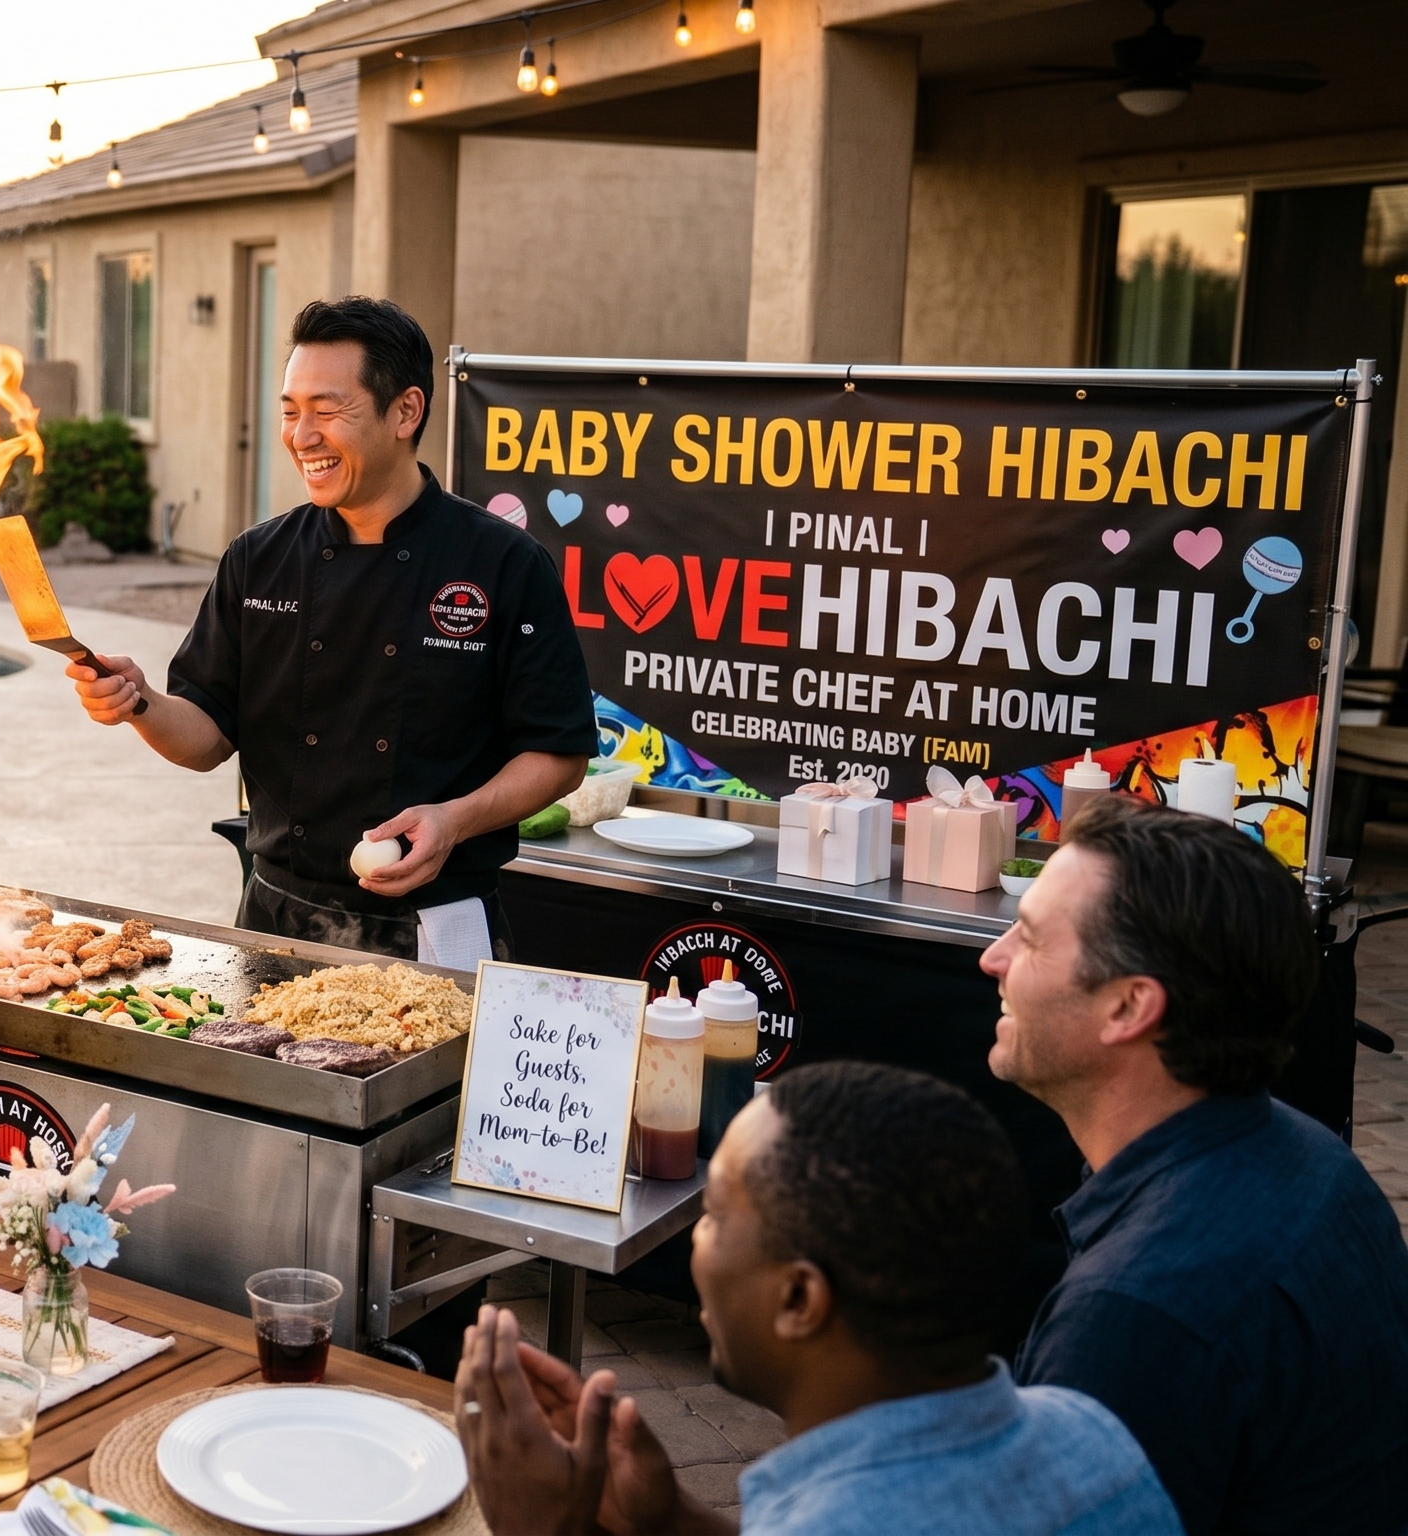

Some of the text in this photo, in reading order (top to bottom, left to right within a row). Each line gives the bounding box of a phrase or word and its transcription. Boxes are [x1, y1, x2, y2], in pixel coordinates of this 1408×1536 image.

[485, 406, 1308, 511] BABY SHOWER HIBACHI
[788, 511, 904, 555] PINAL
[624, 649, 1097, 737] PRIVATE CHEF AT HOME
[691, 709, 845, 750] CELEBRATING
[851, 726, 917, 757] BABY
[788, 754, 828, 782] Est.
[719, 934, 742, 953] AT
[509, 1014, 602, 1055] Sake for
[515, 1049, 586, 1085] Guests,
[8, 1099, 32, 1122] AT
[500, 1081, 594, 1123] Soda for
[478, 1112, 608, 1155] Mom-to-Be!
